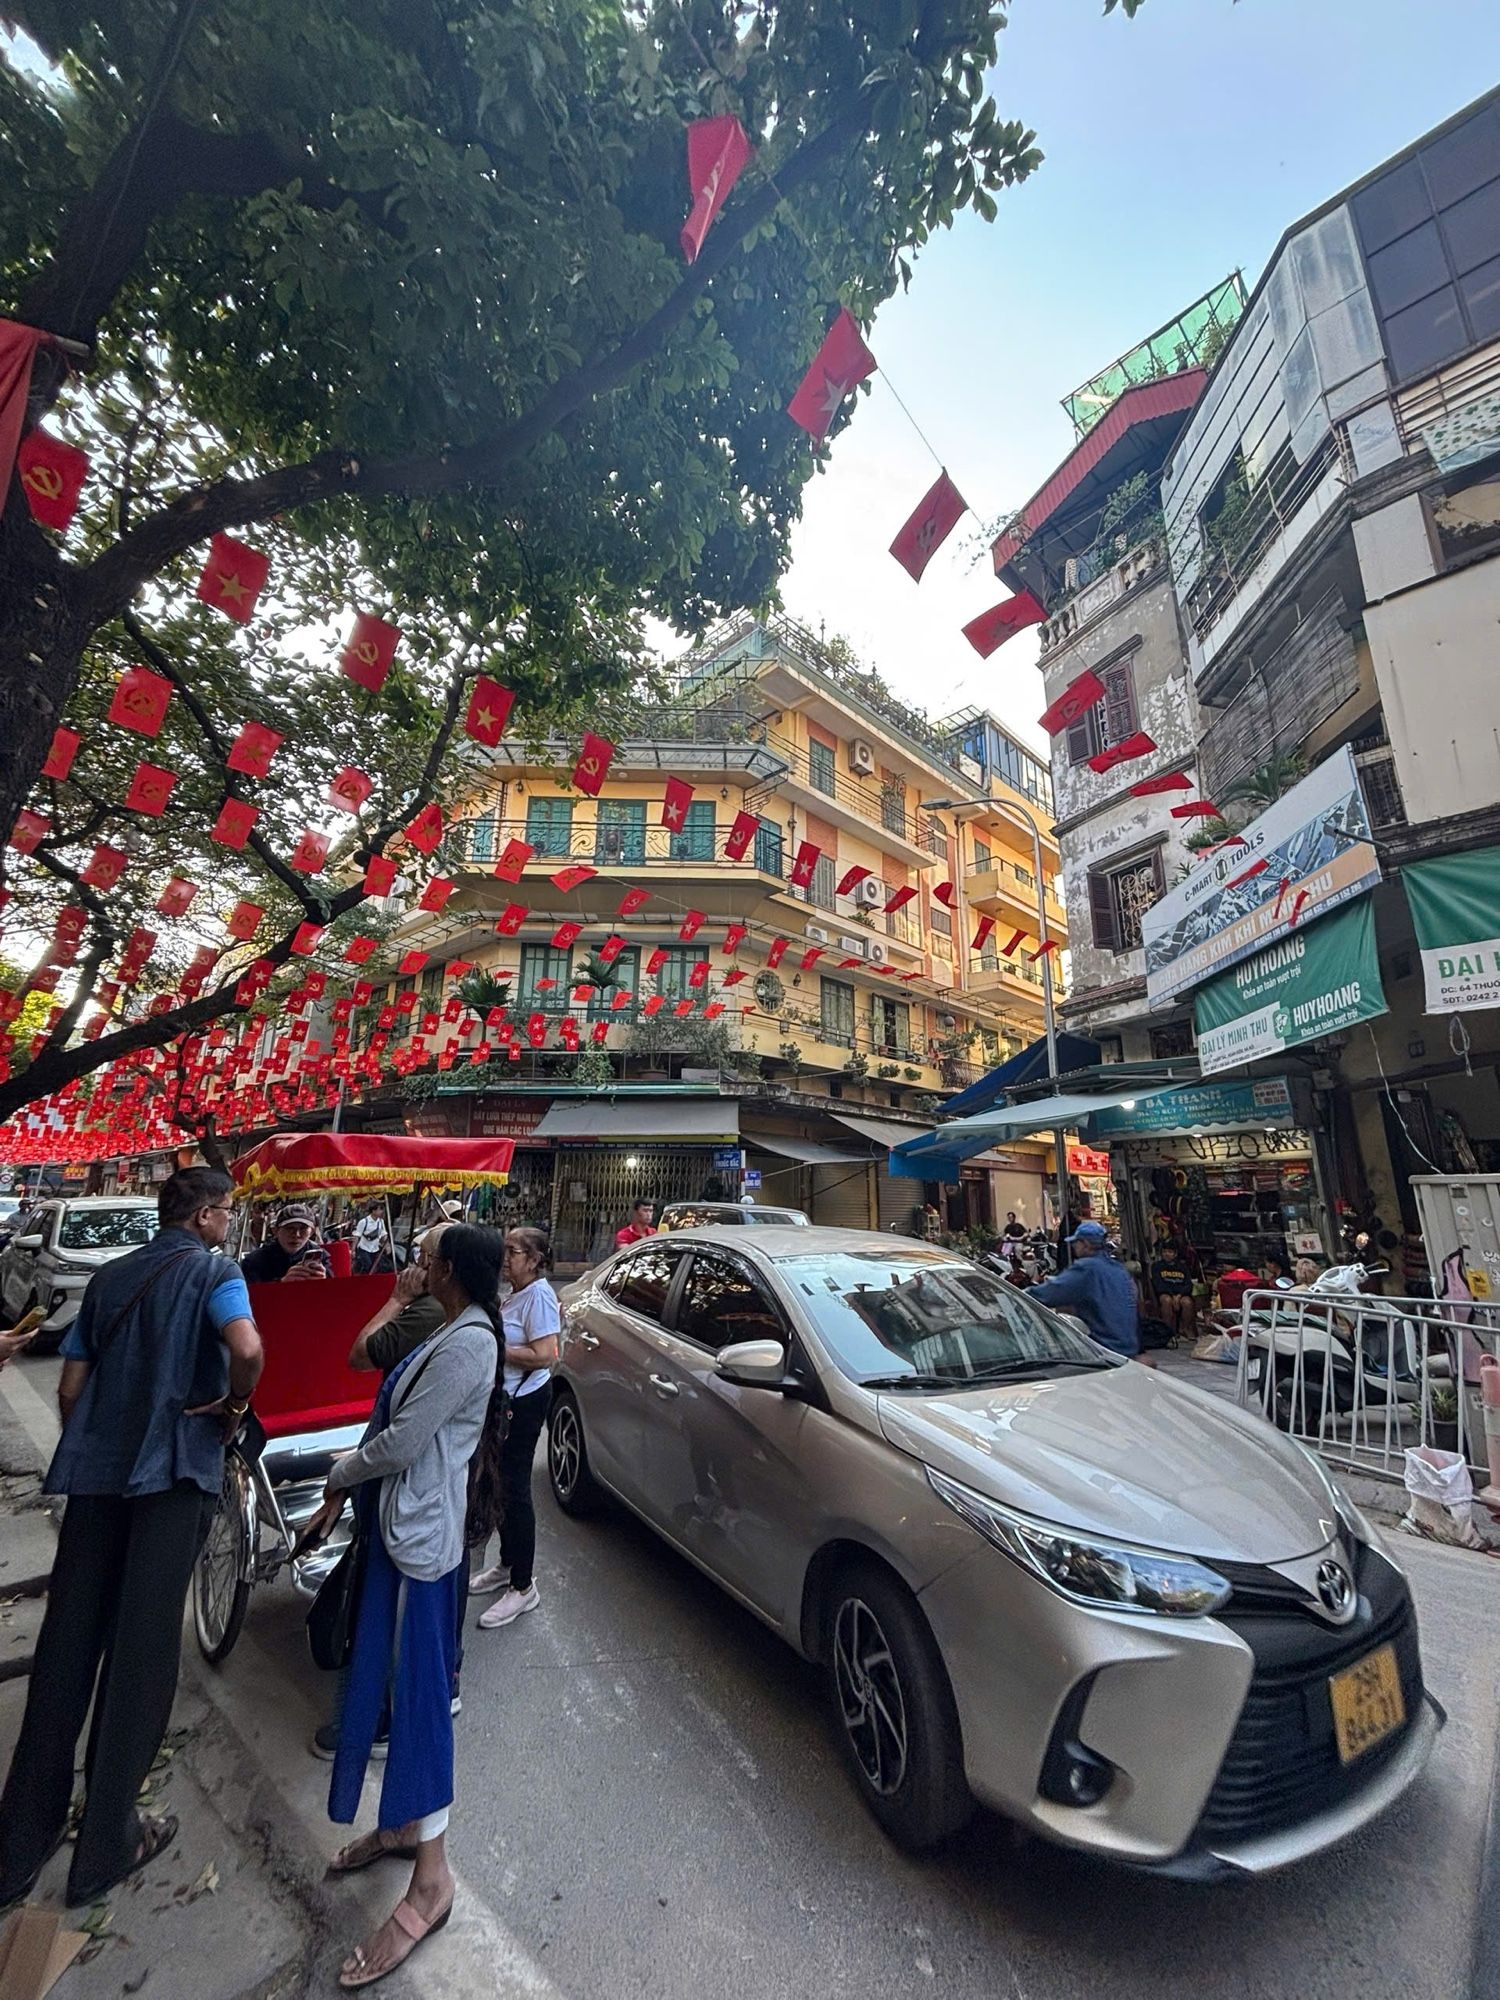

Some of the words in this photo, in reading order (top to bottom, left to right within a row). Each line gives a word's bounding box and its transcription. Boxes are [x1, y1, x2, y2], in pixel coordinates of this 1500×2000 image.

[1185, 873, 1213, 901] C-MART
[1230, 832, 1264, 865] TOOLS
[1210, 933, 1232, 958] KIM
[1259, 890, 1300, 929] MNH
[1303, 871, 1334, 903] HU
[1236, 934, 1305, 989] HUYHOANG
[1439, 954, 1484, 982] ĐẠI
[1293, 981, 1361, 1027] HUYHOANG
[1460, 984, 1471, 992] 64
[1228, 1025, 1248, 1046] MINH
[1250, 1017, 1268, 1038] THU
[1170, 1089, 1221, 1106] THANH
